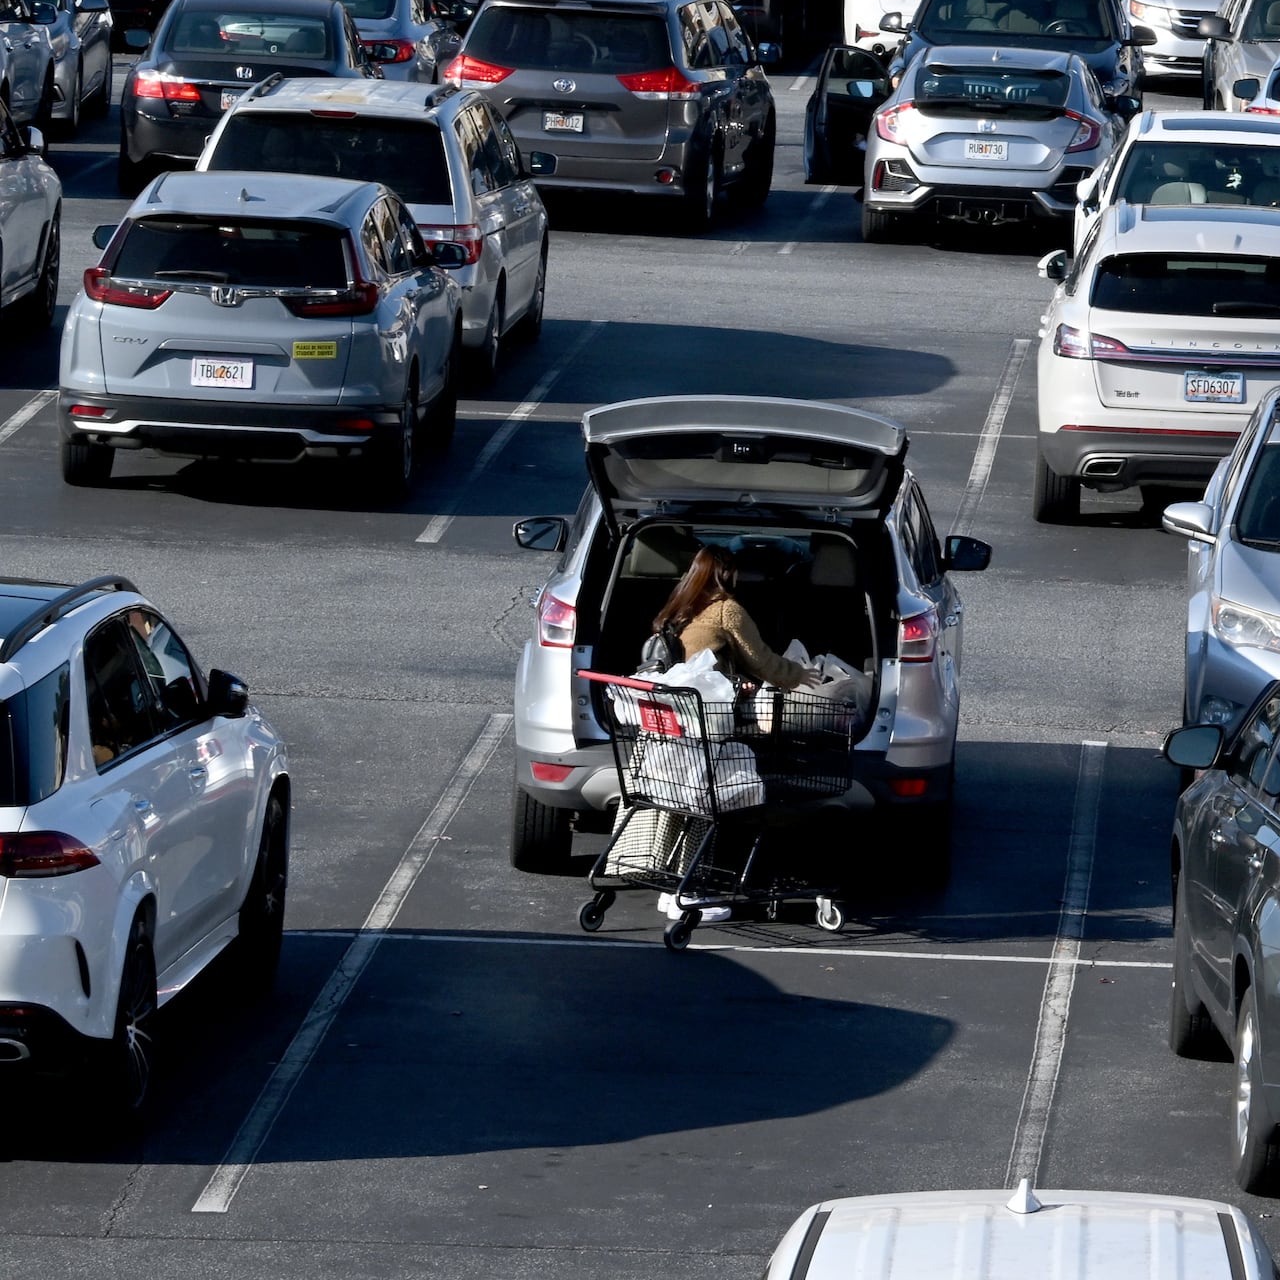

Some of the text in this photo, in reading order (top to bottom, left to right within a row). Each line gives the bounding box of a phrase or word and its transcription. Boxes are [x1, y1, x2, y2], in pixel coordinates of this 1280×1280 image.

[112, 336, 148, 344] CR-V
[200, 363, 244, 380] TBL2621
[1190, 378, 1236, 395] SFD6307
